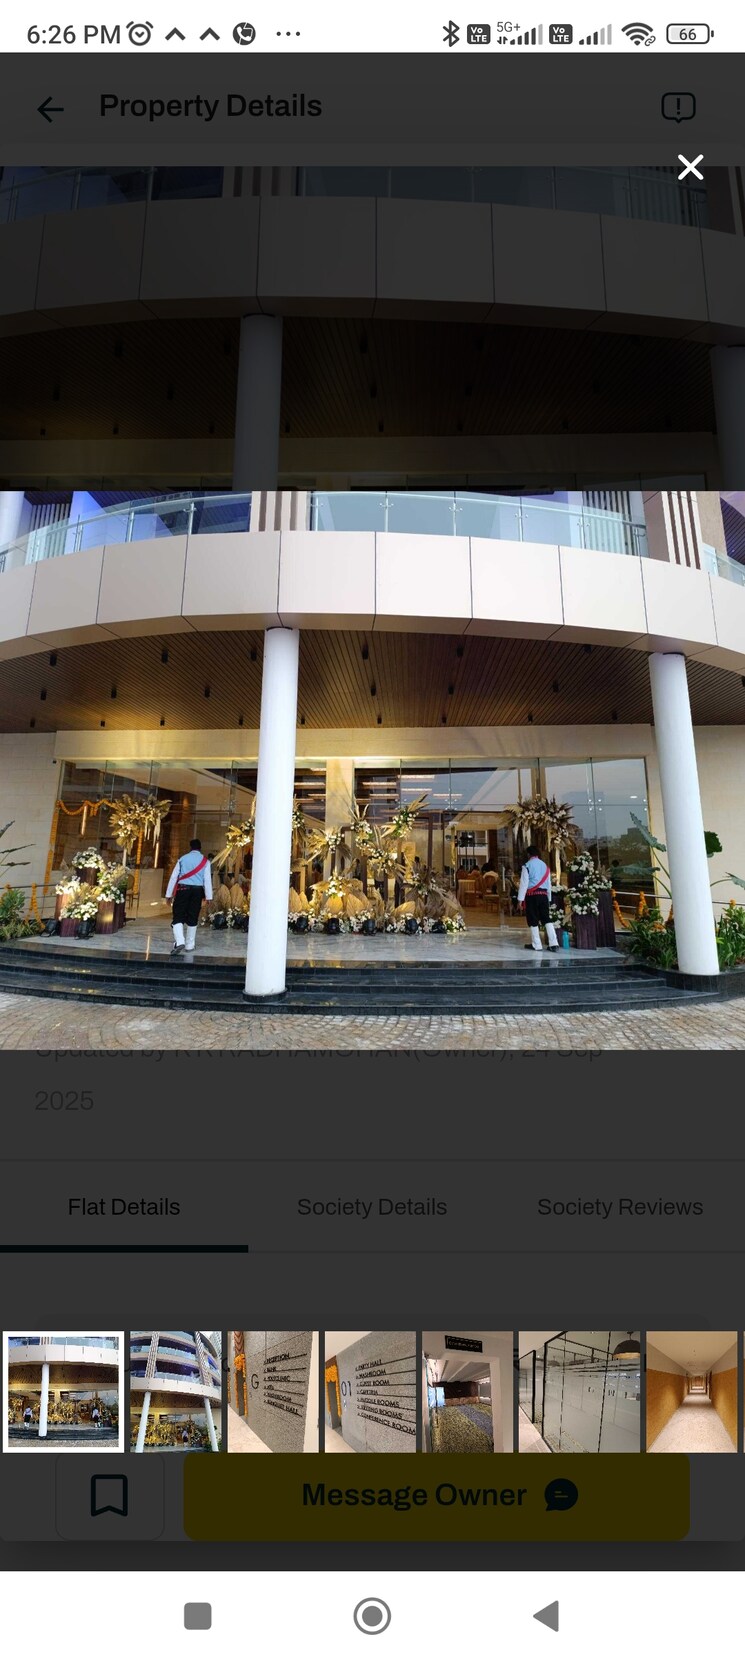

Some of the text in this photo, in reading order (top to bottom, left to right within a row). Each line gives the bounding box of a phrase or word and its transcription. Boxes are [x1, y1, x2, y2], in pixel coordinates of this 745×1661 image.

[27, 25, 120, 44] 6:26 PM
[497, 22, 520, 32] 5G+
[679, 28, 698, 41] 66
[470, 34, 488, 42] LTE
[552, 34, 570, 42] LTE
[100, 93, 322, 122] Property Details
[36, 1091, 93, 1110] 2025
[69, 1198, 180, 1215] Flat Details
[298, 1198, 447, 1219] Society Details
[538, 1198, 703, 1219] Society Reviews
[251, 1374, 259, 1390] G
[341, 1380, 352, 1396] 01
[377, 1400, 400, 1408] ROOMS
[379, 1409, 403, 1419] ROOMS
[303, 1483, 527, 1511] Message Owner
